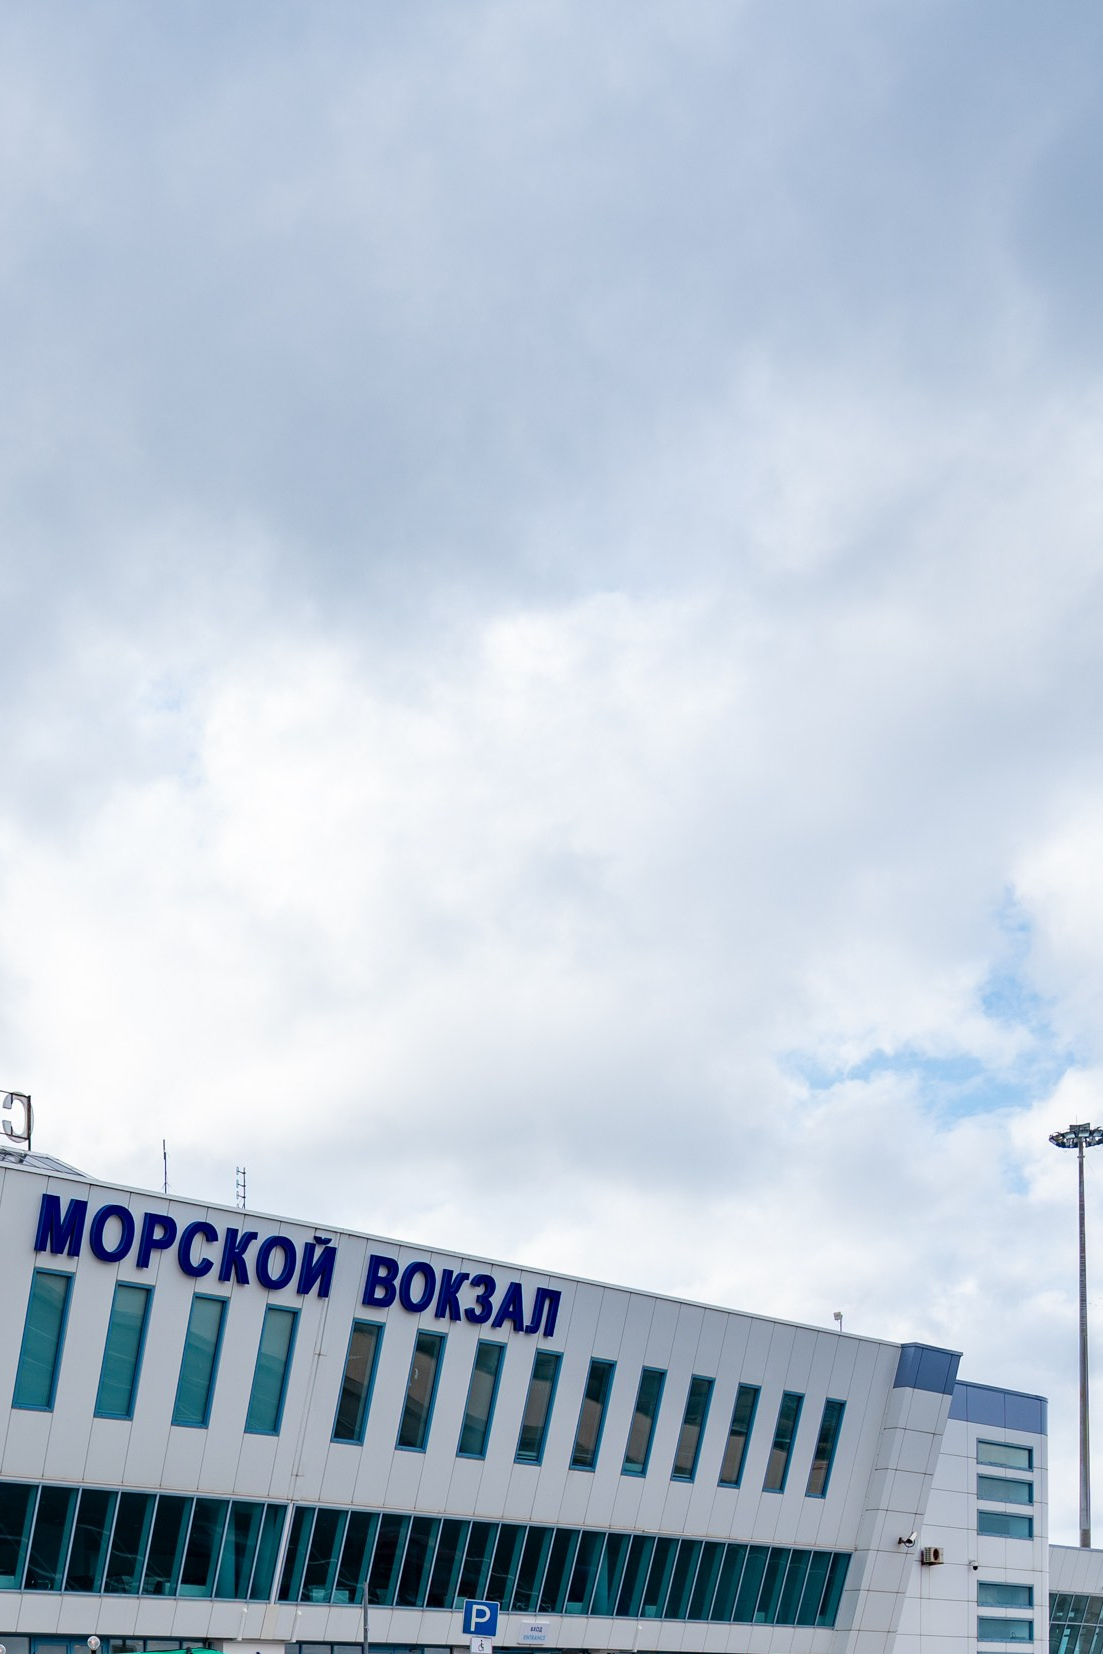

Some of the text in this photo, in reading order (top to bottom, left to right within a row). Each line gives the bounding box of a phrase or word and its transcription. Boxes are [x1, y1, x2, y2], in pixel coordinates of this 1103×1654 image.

[34, 1193, 562, 1338] МОРСКОЙ ВОКЗАЛ
[470, 1604, 491, 1632] P
